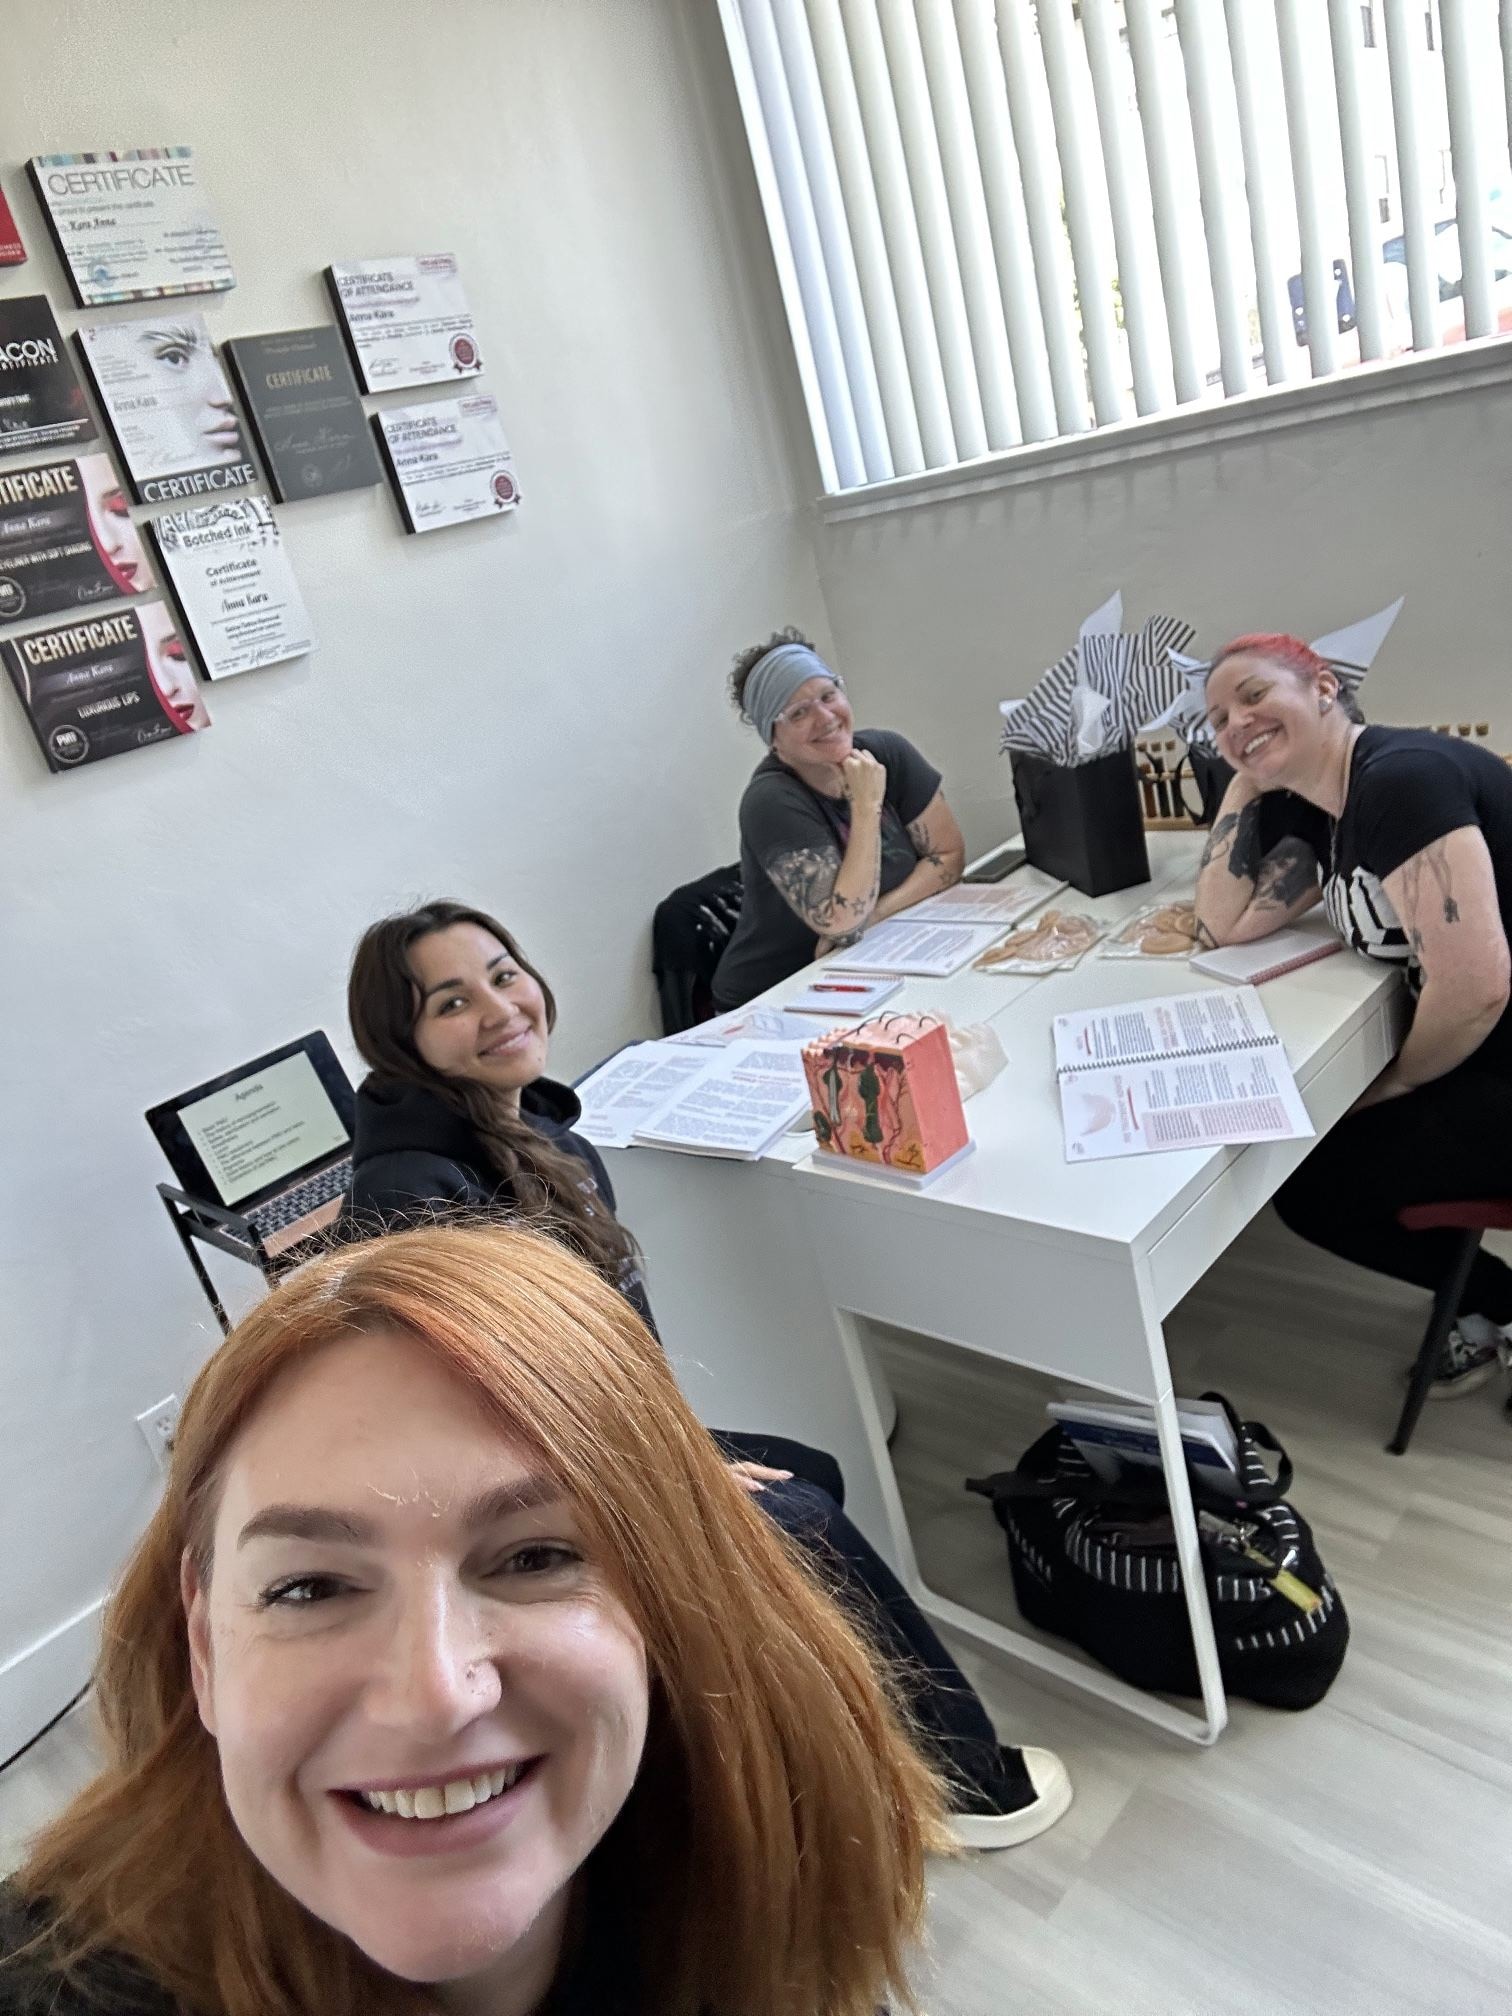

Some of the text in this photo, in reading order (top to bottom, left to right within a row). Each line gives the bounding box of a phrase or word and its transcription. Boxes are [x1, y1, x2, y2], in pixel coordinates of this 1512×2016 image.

[48, 165, 195, 195] CERTIFICATE
[337, 272, 394, 287] CERTIFICATE
[340, 281, 414, 298] OF ATTENDANCE
[265, 365, 334, 390] CERTIFICATE
[386, 417, 438, 433] CERTIFICATE
[388, 424, 457, 444] OF ATTENDANCE
[143, 464, 256, 503] CERTIFICATE
[182, 527, 233, 548] Botched
[234, 523, 252, 537] Ink
[205, 558, 258, 577] Certificate
[23, 615, 138, 665] CERTIFICATE
[235, 1083, 264, 1102] Agenda
